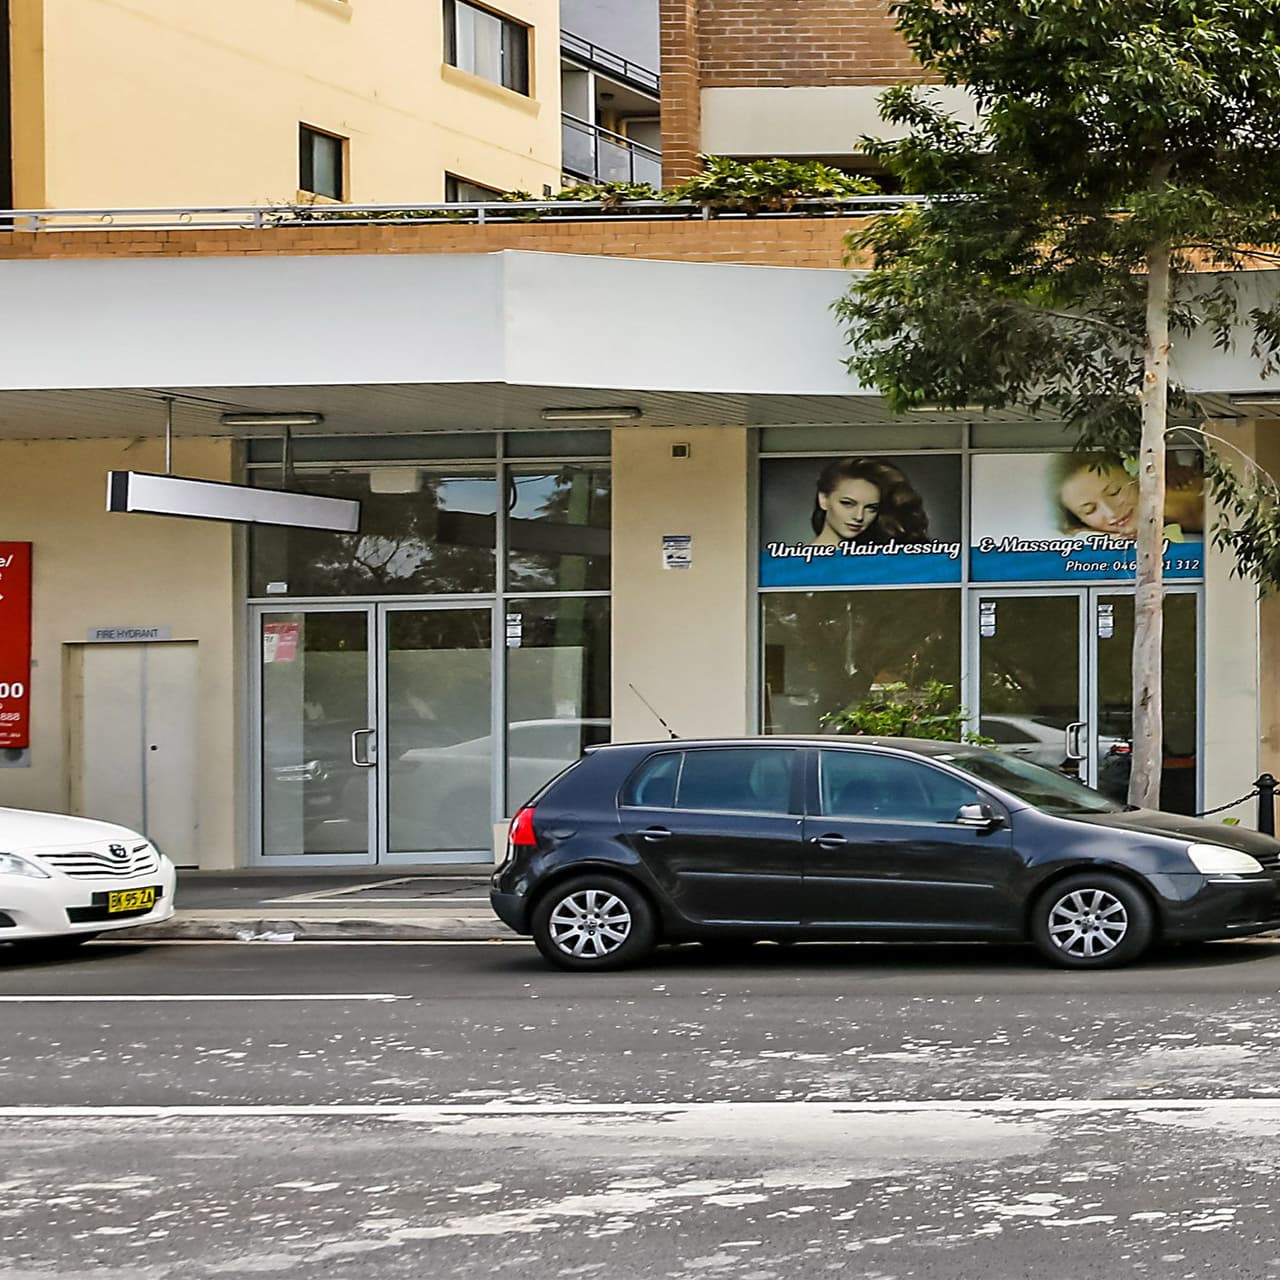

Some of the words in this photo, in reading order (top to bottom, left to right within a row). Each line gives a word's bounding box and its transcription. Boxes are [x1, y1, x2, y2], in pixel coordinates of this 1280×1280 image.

[767, 542, 834, 563] Unique
[838, 538, 961, 560] Hairdressing
[979, 537, 995, 553] &
[998, 535, 1083, 557] Massage
[1065, 560, 1109, 572] Phone:
[1176, 559, 1200, 570] 312
[116, 628, 159, 639] HYDRANT
